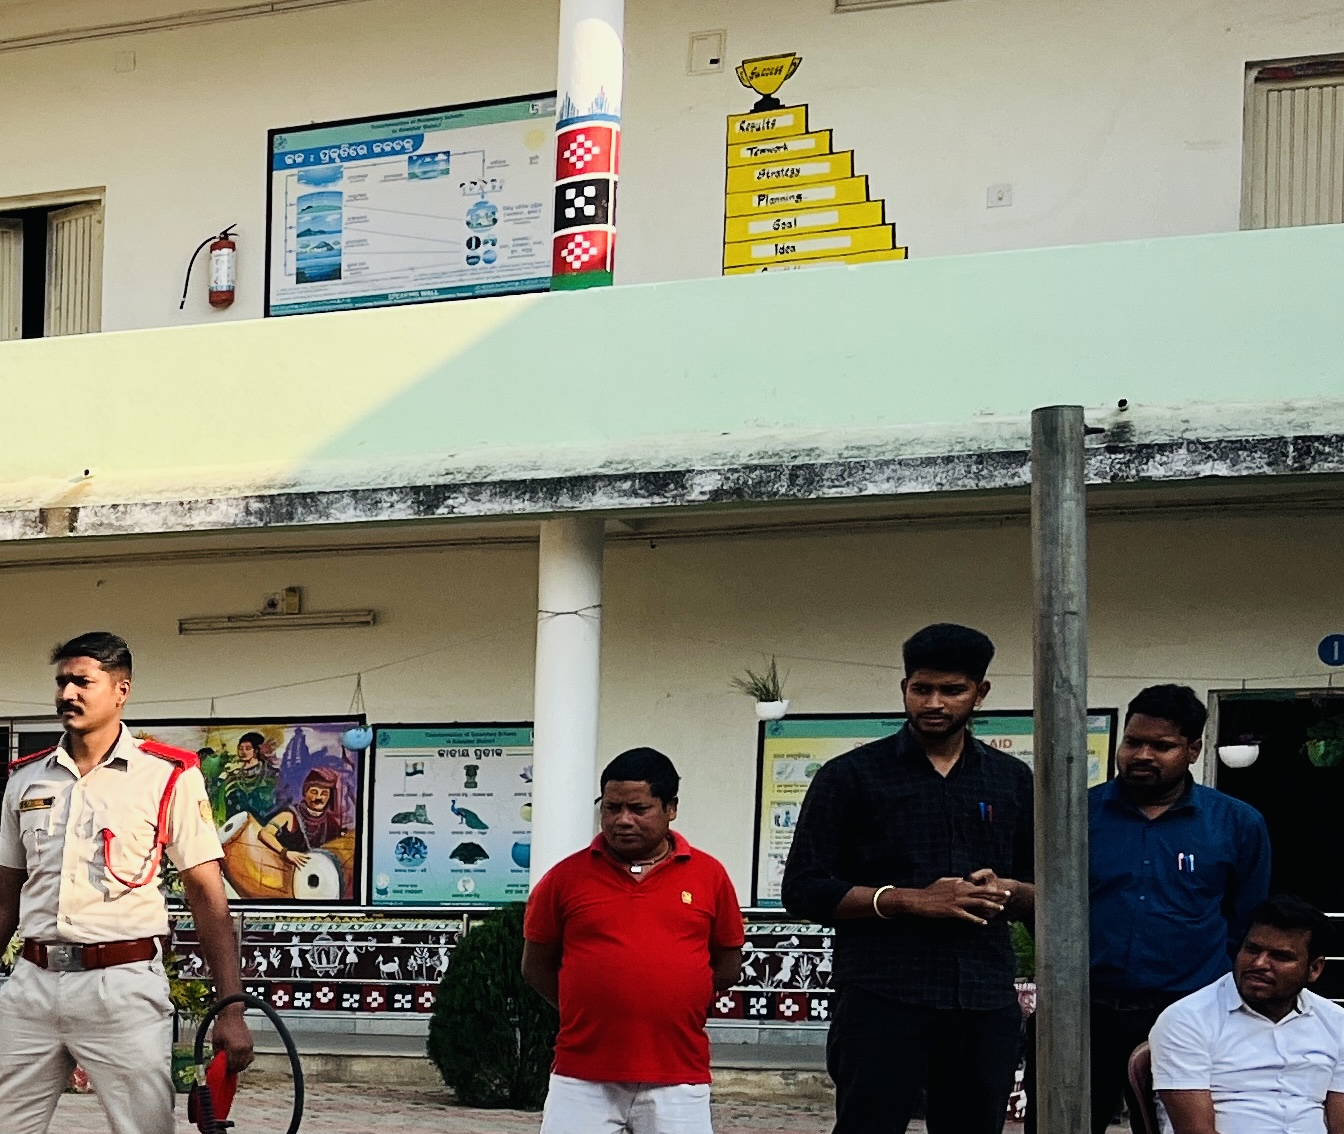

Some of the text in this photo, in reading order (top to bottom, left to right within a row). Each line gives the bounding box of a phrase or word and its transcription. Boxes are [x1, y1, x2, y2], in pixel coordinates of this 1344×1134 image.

[739, 119, 776, 133] Results
[757, 167, 801, 180] Strategy
[772, 218, 797, 231] Goal
[774, 243, 796, 255] Idea
